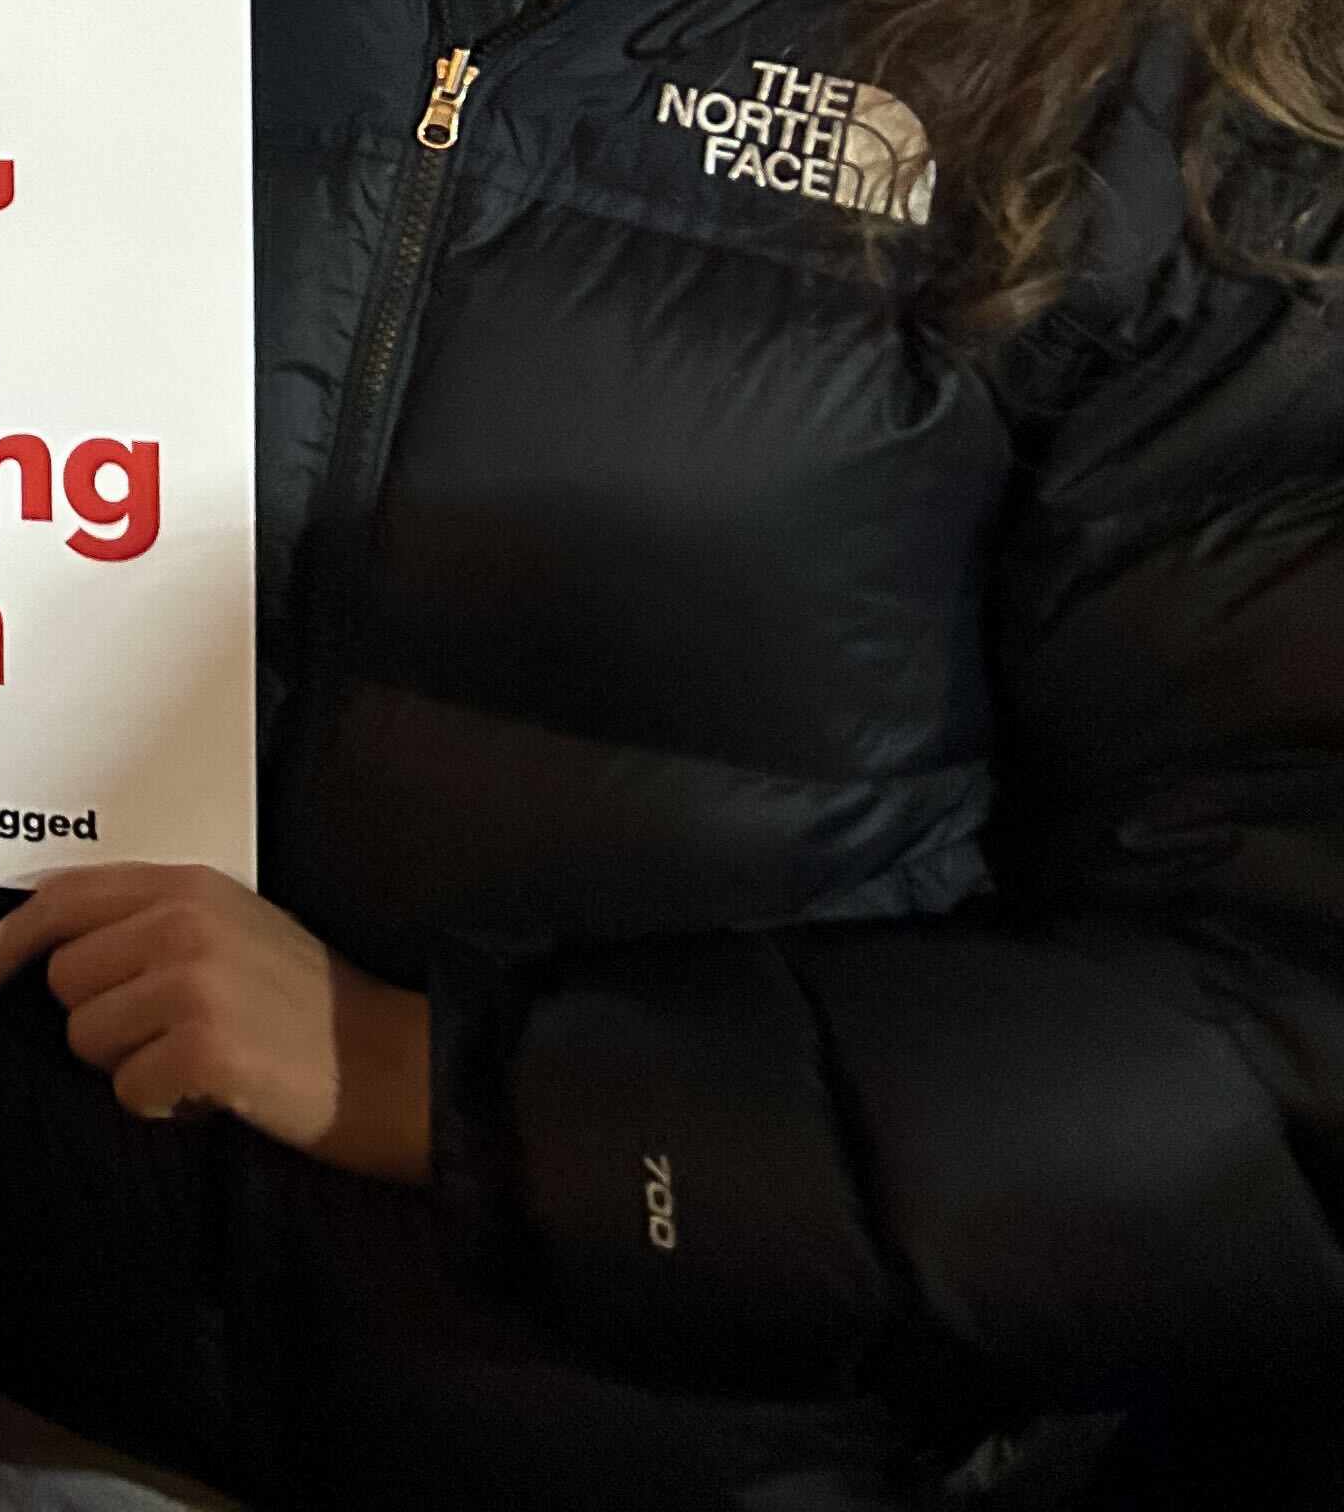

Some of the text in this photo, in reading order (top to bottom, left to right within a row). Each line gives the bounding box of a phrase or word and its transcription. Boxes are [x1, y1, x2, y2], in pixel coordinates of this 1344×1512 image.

[657, 83, 844, 162] NORTH
[752, 60, 855, 119] THE
[703, 135, 836, 200] FACE
[643, 1154, 677, 1249] 700
